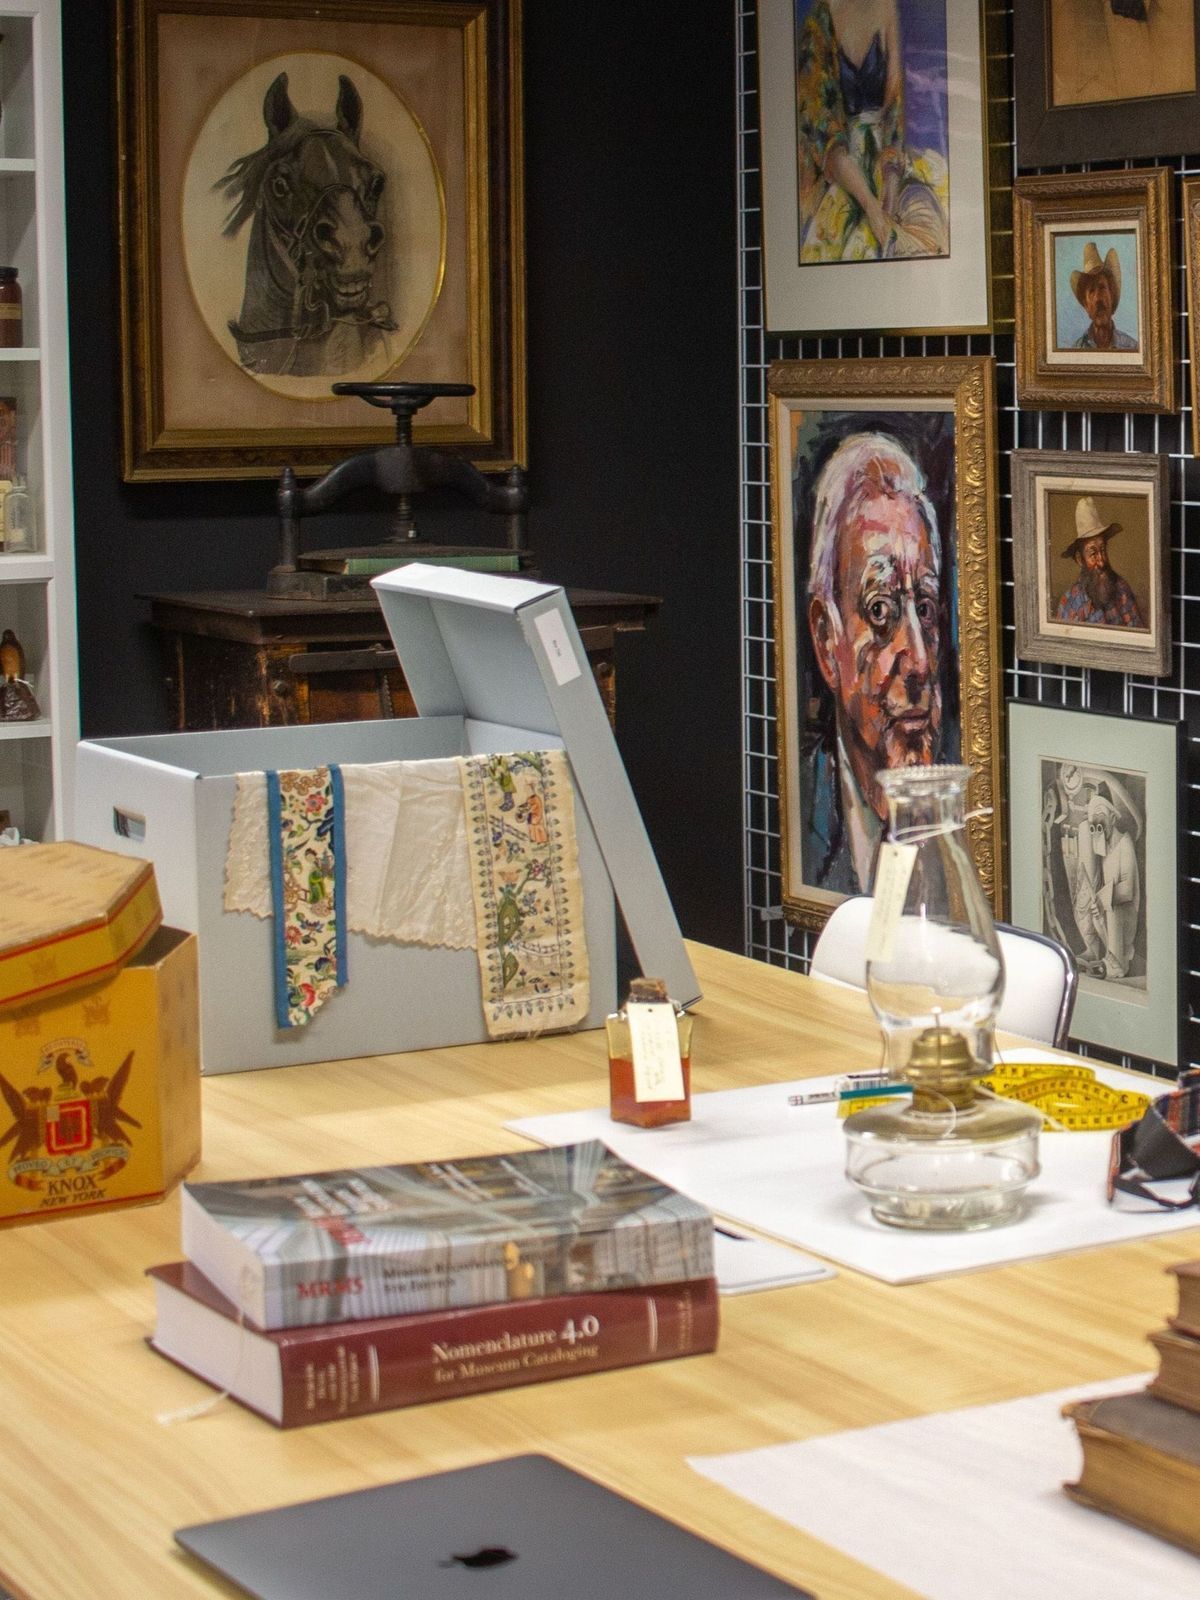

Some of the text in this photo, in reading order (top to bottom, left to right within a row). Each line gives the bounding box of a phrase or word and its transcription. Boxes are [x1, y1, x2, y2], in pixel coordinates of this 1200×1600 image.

[41, 1188, 106, 1206] NEW YORK
[48, 1174, 99, 1196] KNOX
[431, 1314, 600, 1364] Nomenclature 4.0
[433, 1344, 600, 1383] for Museum Cataloging
